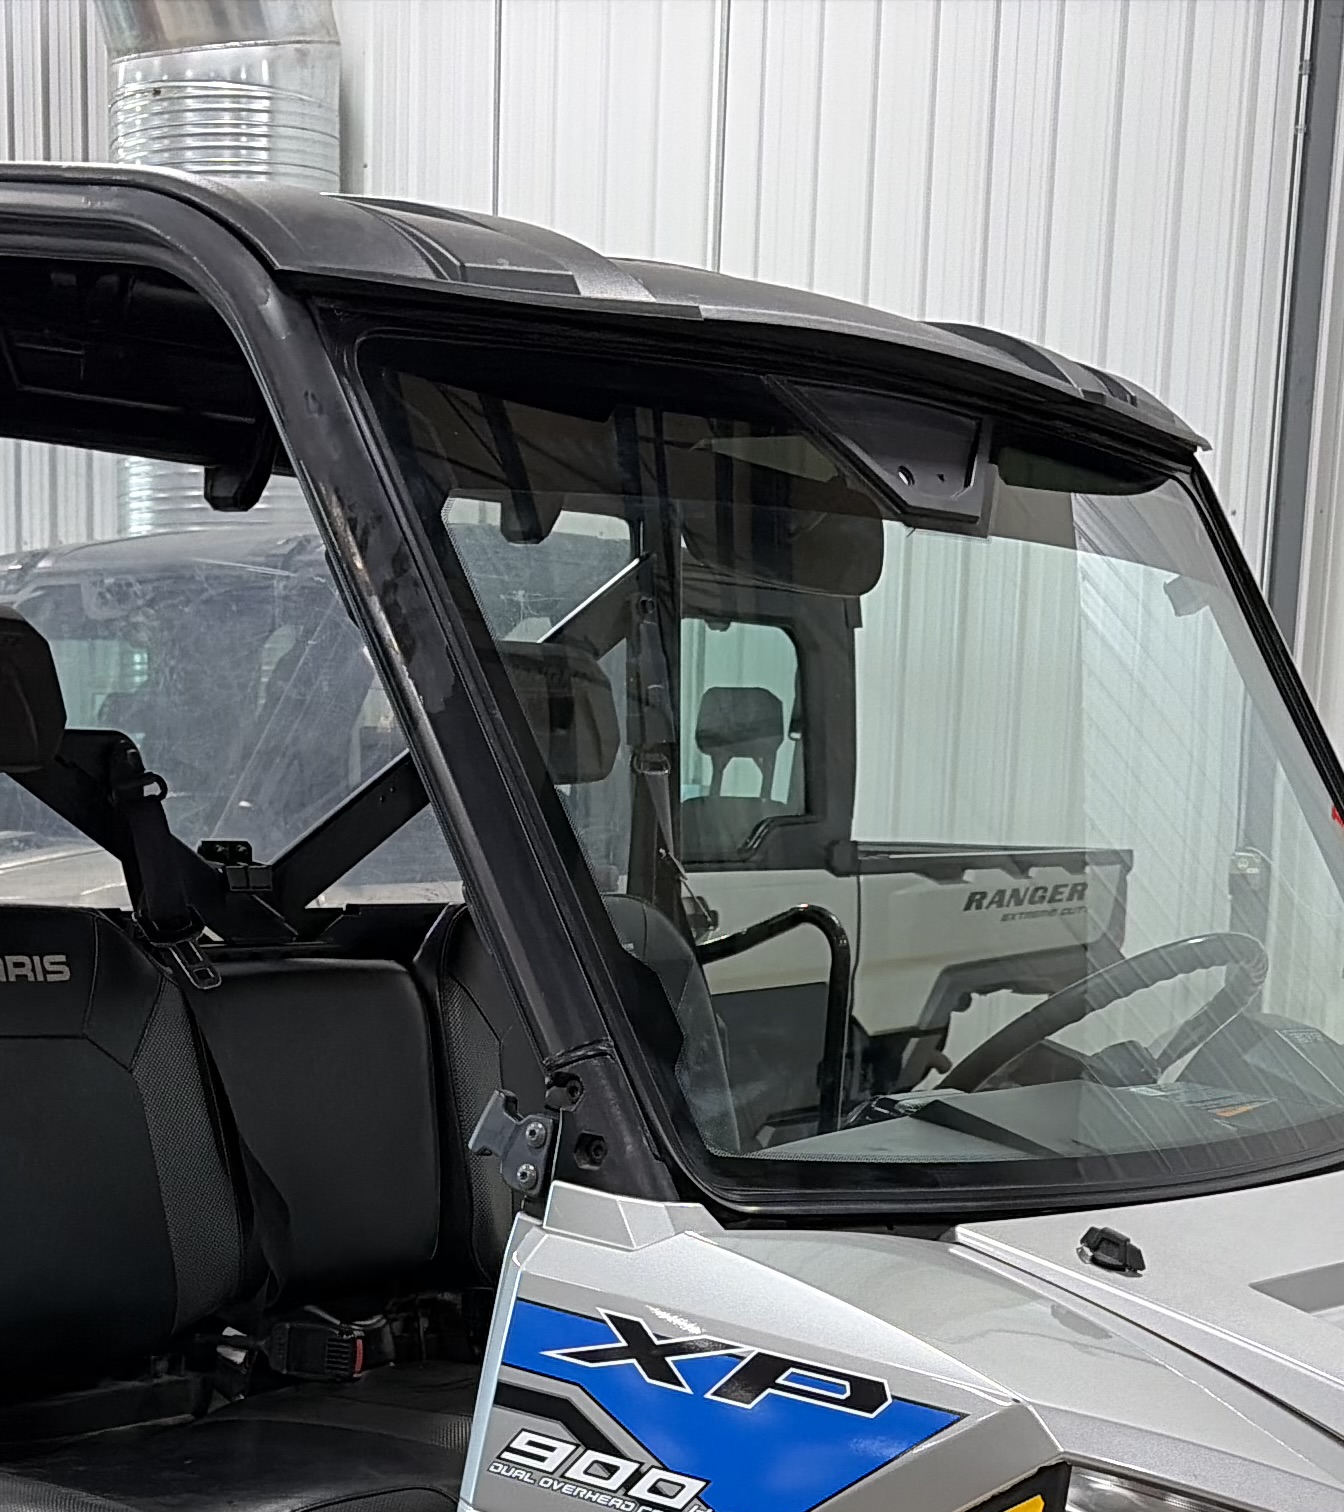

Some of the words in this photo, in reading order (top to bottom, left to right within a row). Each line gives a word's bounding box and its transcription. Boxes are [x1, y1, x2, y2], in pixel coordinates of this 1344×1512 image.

[962, 881, 1089, 912] RANGER
[540, 1306, 893, 1419] XP
[487, 1461, 536, 1484] DUAL
[538, 1477, 639, 1512] OVERHEAD
[496, 1428, 712, 1512] 900
